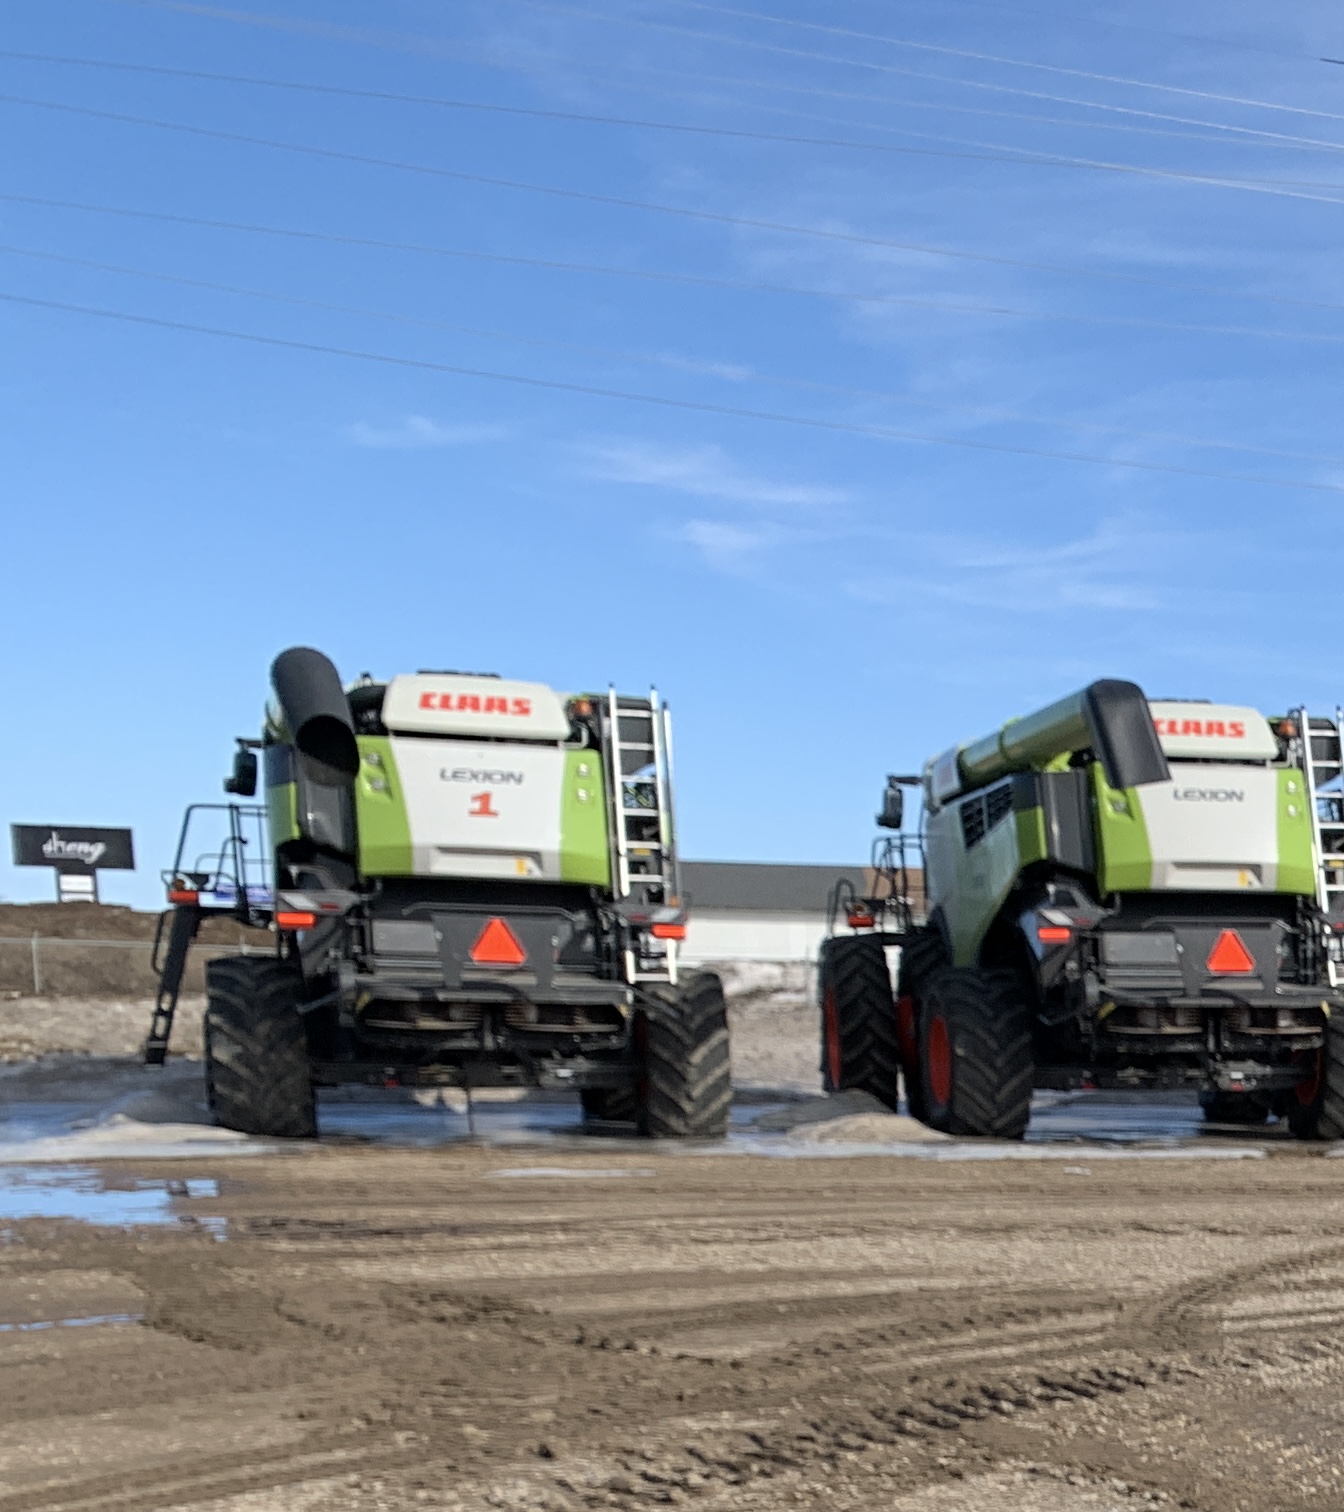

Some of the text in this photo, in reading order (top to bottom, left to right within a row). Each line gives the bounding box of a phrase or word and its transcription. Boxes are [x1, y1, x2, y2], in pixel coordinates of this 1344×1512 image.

[419, 692, 531, 717] CLAAS
[440, 767, 524, 785] LEXION
[468, 791, 499, 818] 1
[1173, 787, 1244, 802] LEXION
